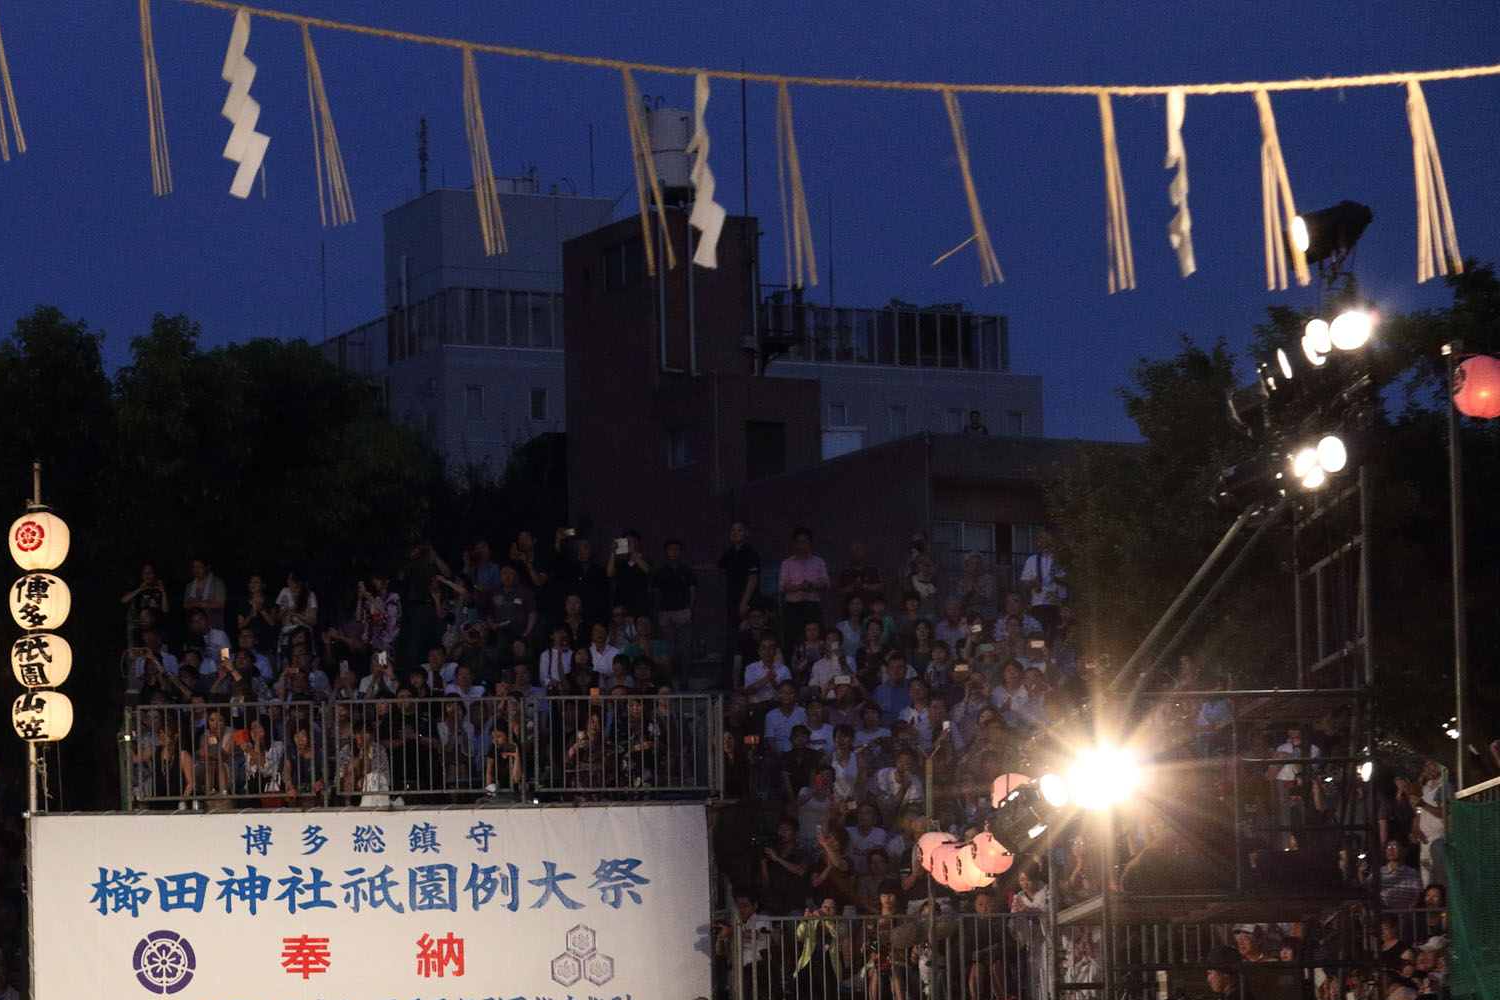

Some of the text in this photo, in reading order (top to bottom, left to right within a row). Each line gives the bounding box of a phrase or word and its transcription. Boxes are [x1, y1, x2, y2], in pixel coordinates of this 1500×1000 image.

[241, 820, 498, 857] 博多総鎮守
[90, 857, 651, 919] 櫛田神社祇園例大祭
